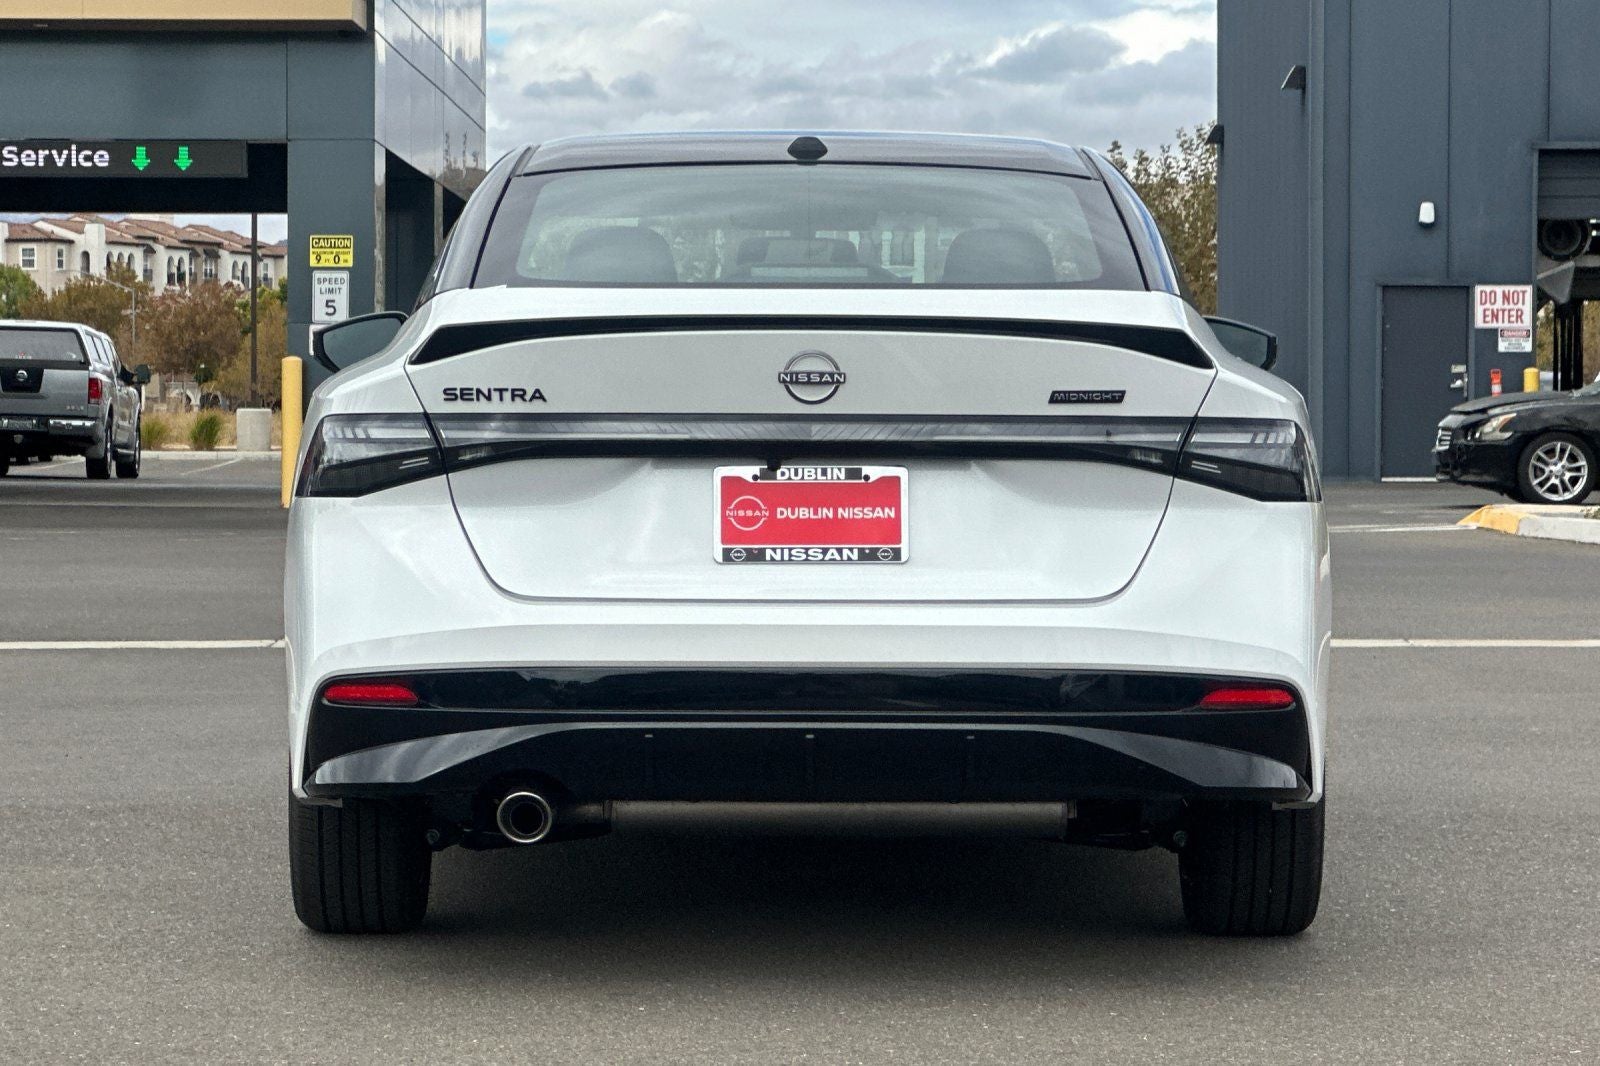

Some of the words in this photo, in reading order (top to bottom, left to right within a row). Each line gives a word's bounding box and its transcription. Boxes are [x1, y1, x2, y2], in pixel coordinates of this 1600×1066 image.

[2, 144, 110, 167] Service
[312, 238, 351, 248] CAUTION
[315, 254, 321, 264] 9
[316, 277, 346, 285] SPEED
[319, 287, 342, 295] LIMIT
[1479, 290, 1497, 306] DO
[1502, 290, 1527, 306] NOT
[325, 299, 336, 316] 5
[1482, 308, 1524, 324] ENTER
[780, 373, 844, 382] NISSAN
[442, 387, 547, 402] SENTRA
[1053, 392, 1122, 401] MIDNIGHT
[776, 467, 846, 480] DUBLIN
[726, 509, 769, 517] NISSAN
[776, 507, 833, 519] DUBLIN
[837, 507, 896, 519] NISSAN
[765, 548, 859, 561] NISSAN
